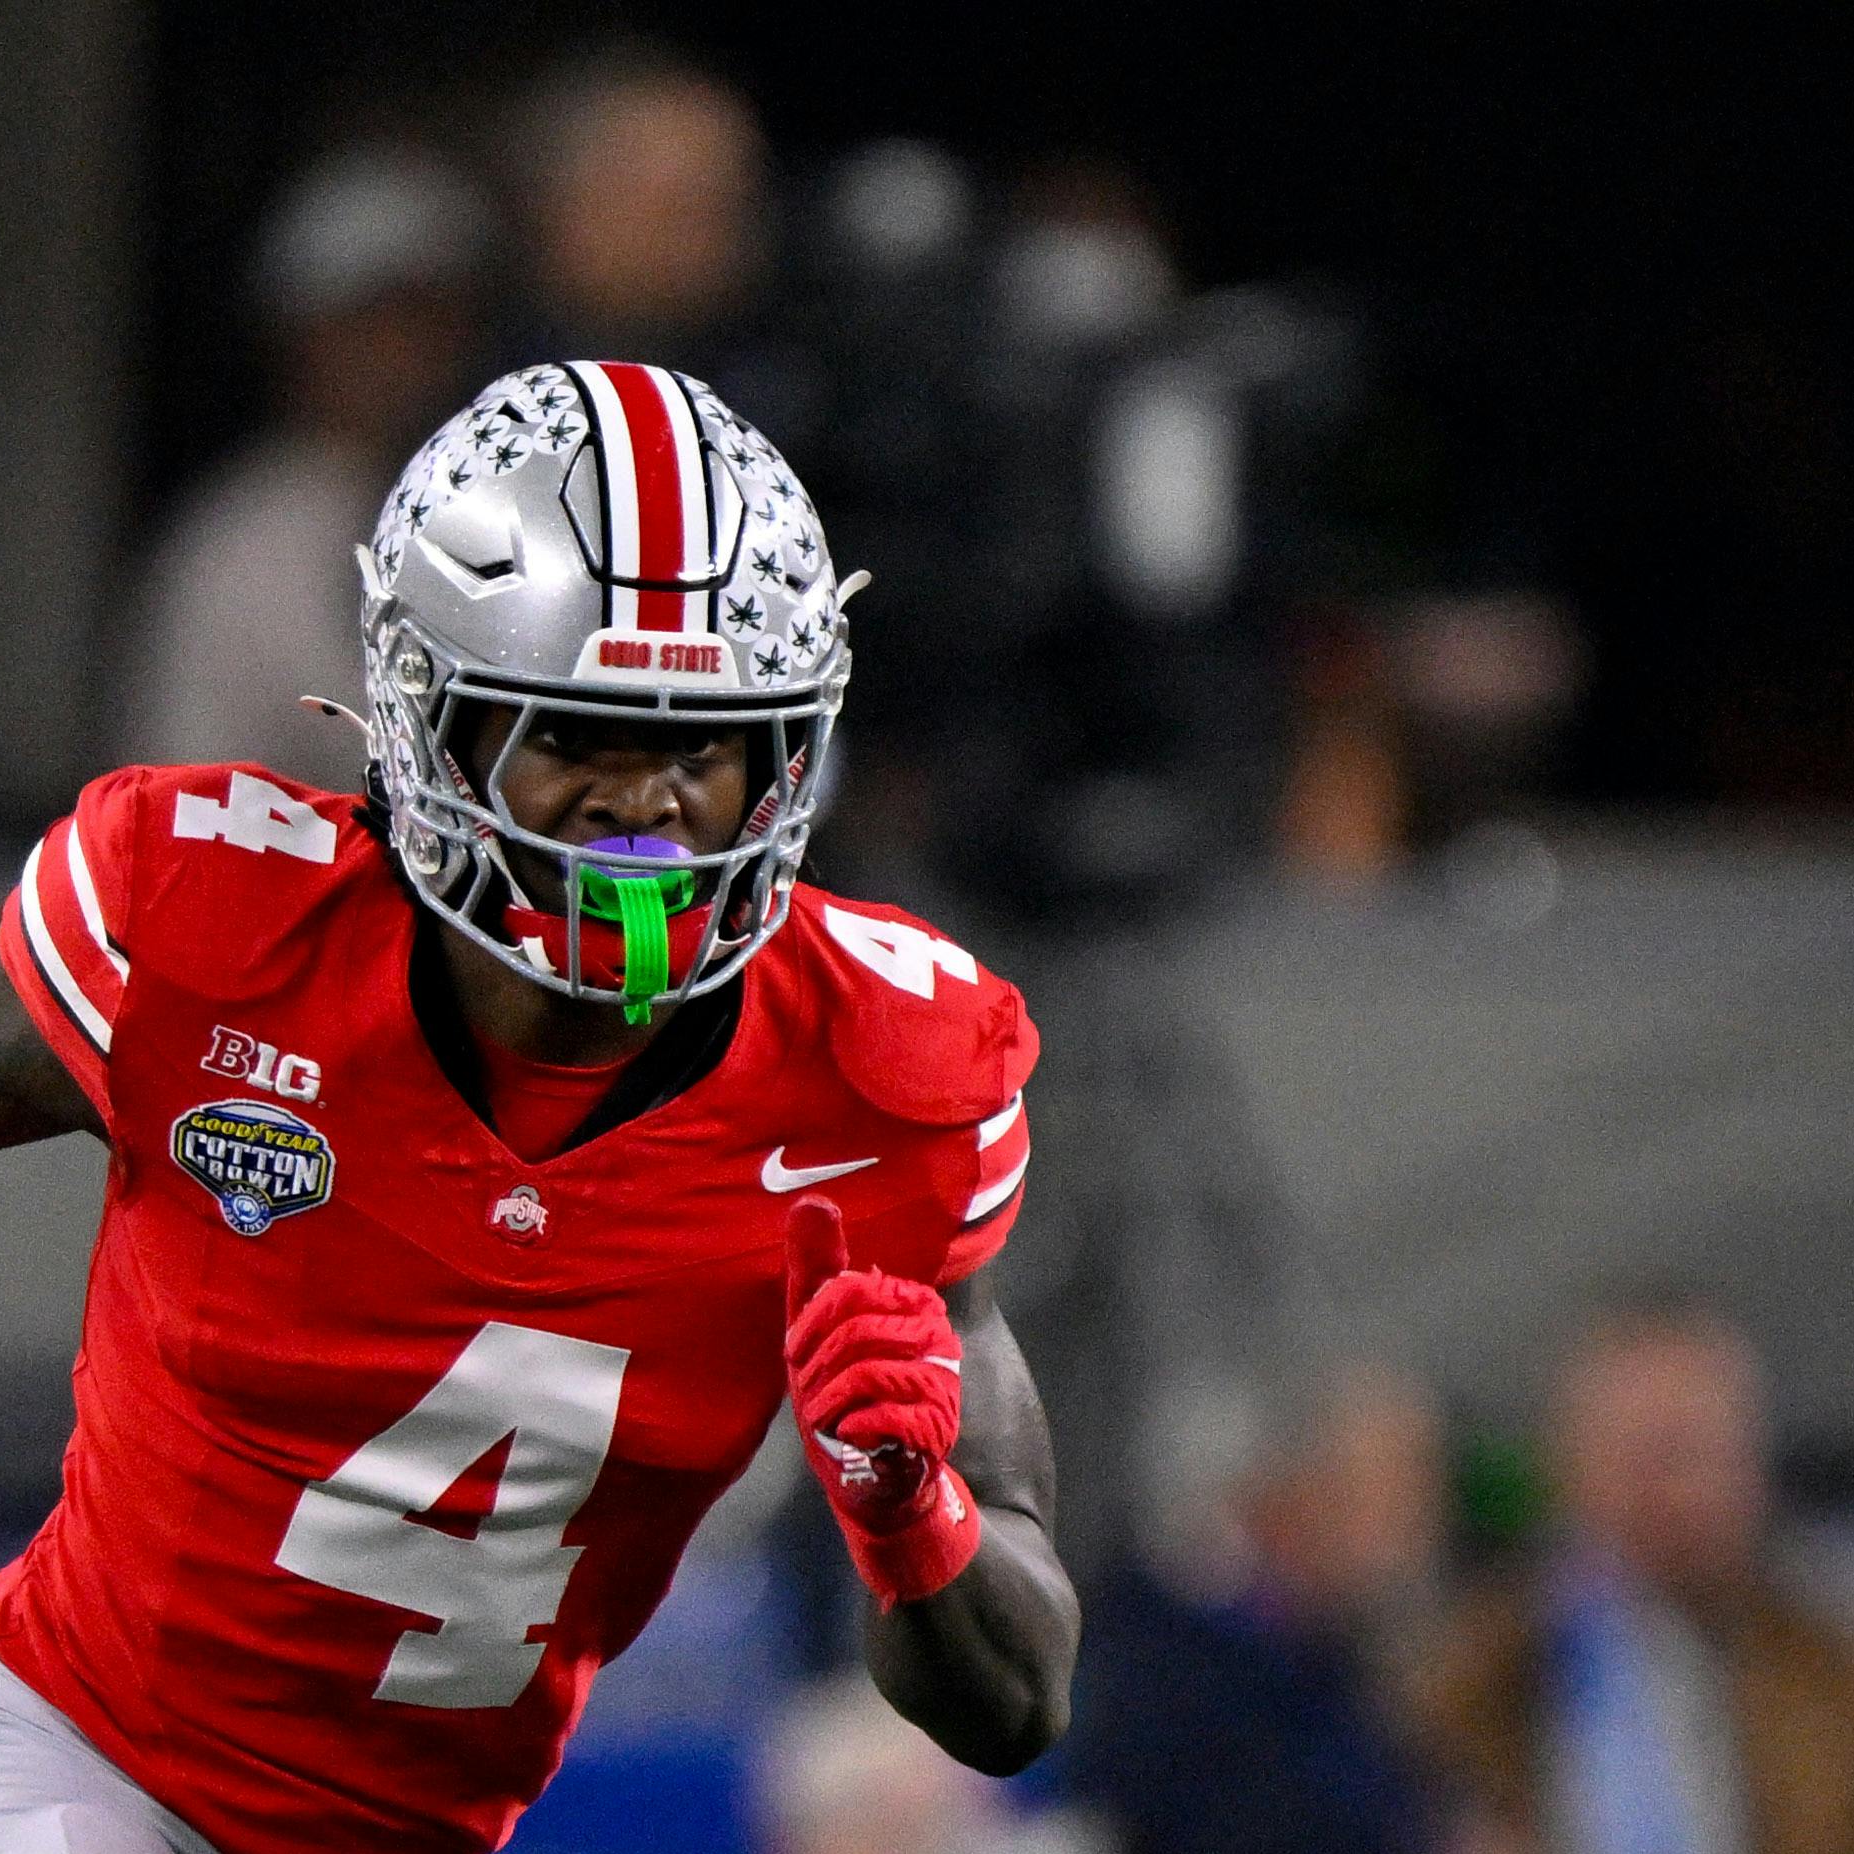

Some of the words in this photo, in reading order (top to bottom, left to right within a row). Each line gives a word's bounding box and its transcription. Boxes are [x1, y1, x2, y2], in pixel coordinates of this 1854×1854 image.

[599, 640, 651, 668] OHIO
[660, 643, 722, 673] STATE
[173, 770, 338, 865] 4
[824, 903, 979, 1001] 4
[185, 1131, 320, 1195] COTTON
[208, 1160, 290, 1198] BOWL
[274, 1320, 631, 1710] 4
